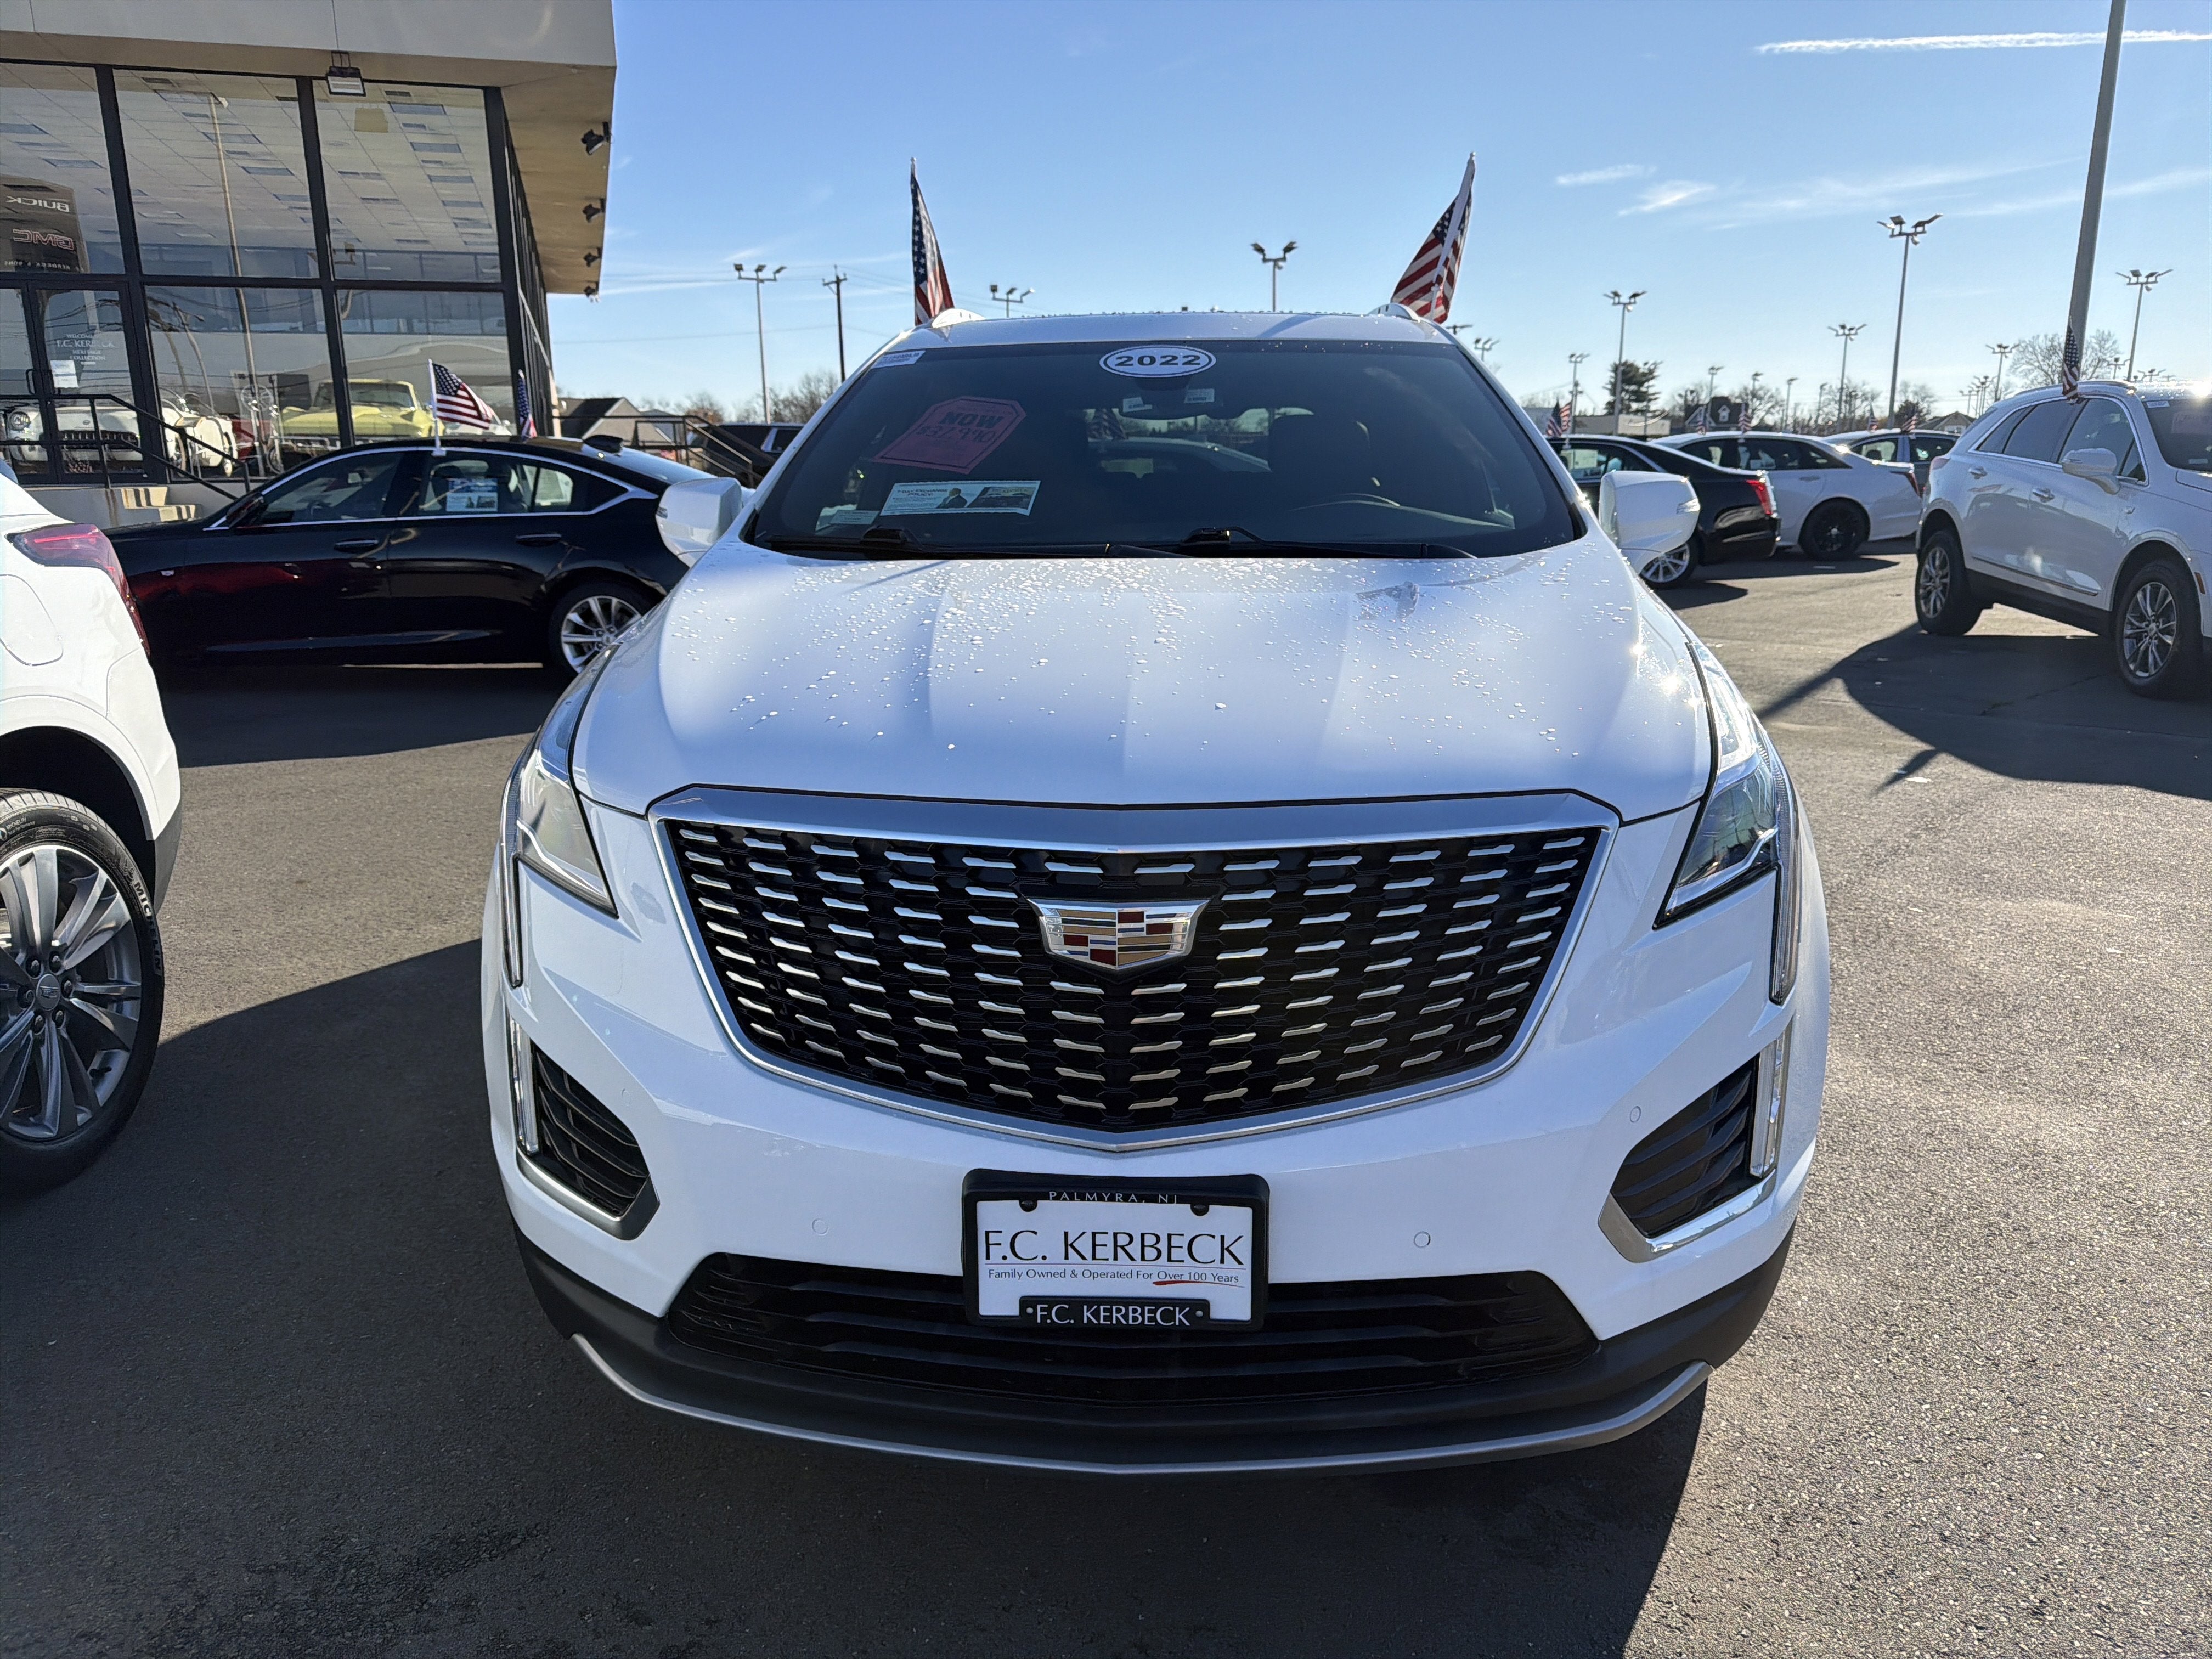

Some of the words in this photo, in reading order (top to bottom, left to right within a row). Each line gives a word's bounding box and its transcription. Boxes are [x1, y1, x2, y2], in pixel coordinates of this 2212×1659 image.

[74, 340, 115, 348] KERBCK
[1115, 354, 1201, 366] 2022
[939, 411, 1006, 428] NOW
[1049, 1191, 1145, 1204] PALMYRA,
[1158, 1194, 1177, 1204] NJ
[984, 1230, 1047, 1261] F.C.
[1063, 1231, 1244, 1266] KERBECK
[989, 1268, 1023, 1280] Family
[1026, 1268, 1066, 1279] Owned
[1070, 1269, 1078, 1279] &
[1082, 1269, 1133, 1280] Operated
[1136, 1270, 1153, 1279] For
[1157, 1270, 1184, 1280] Over
[1187, 1272, 1207, 1282] 100
[1211, 1272, 1239, 1283] Years
[1036, 1304, 1075, 1324] F.C.
[1083, 1305, 1191, 1326] KERBECK
